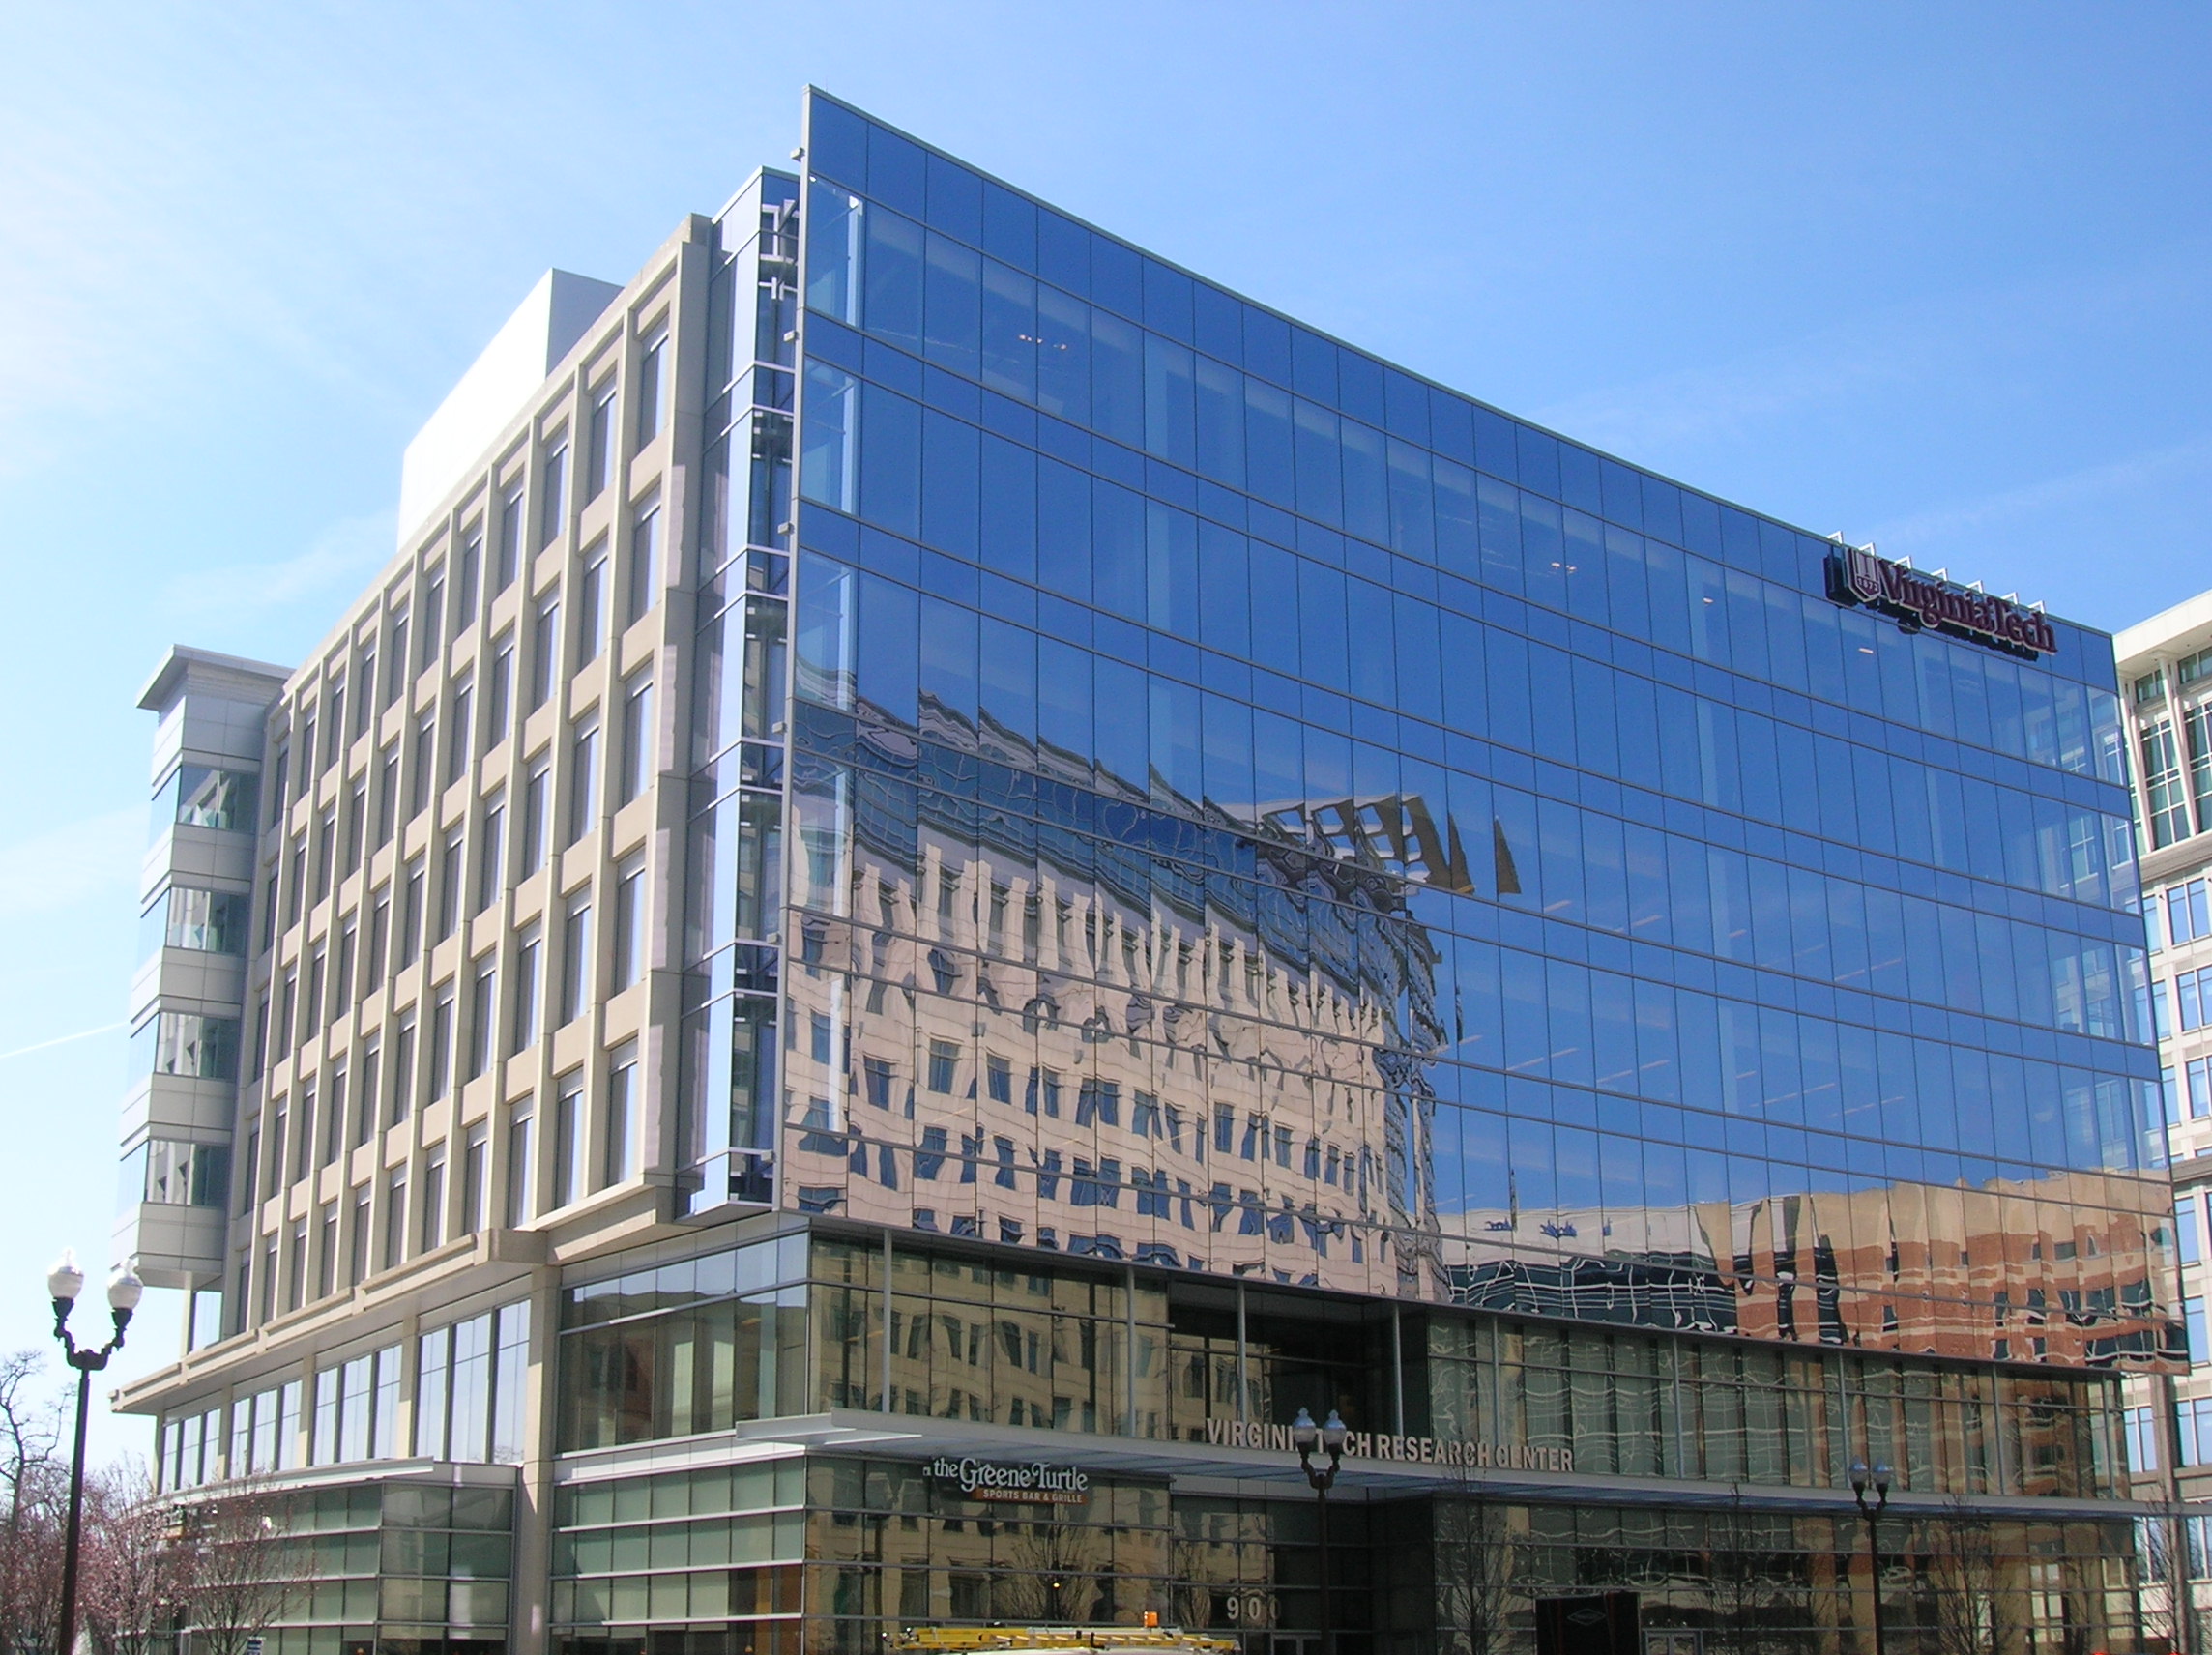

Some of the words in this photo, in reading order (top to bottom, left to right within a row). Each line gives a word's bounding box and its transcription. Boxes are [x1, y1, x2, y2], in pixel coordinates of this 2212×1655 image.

[1207, 1418, 1300, 1451] VIRGINI
[1315, 1428, 1371, 1458] TCH
[1377, 1433, 1492, 1467] RESEARCH
[1496, 1444, 1574, 1471] CENTER
[934, 1457, 958, 1478] the
[959, 1457, 1031, 1492] Greene
[1031, 1462, 1089, 1491] Turtle
[982, 1489, 1019, 1499] SPORTS
[1022, 1492, 1040, 1501] BAR
[1052, 1493, 1083, 1503] GRILLE
[1226, 1596, 1281, 1620] 900
